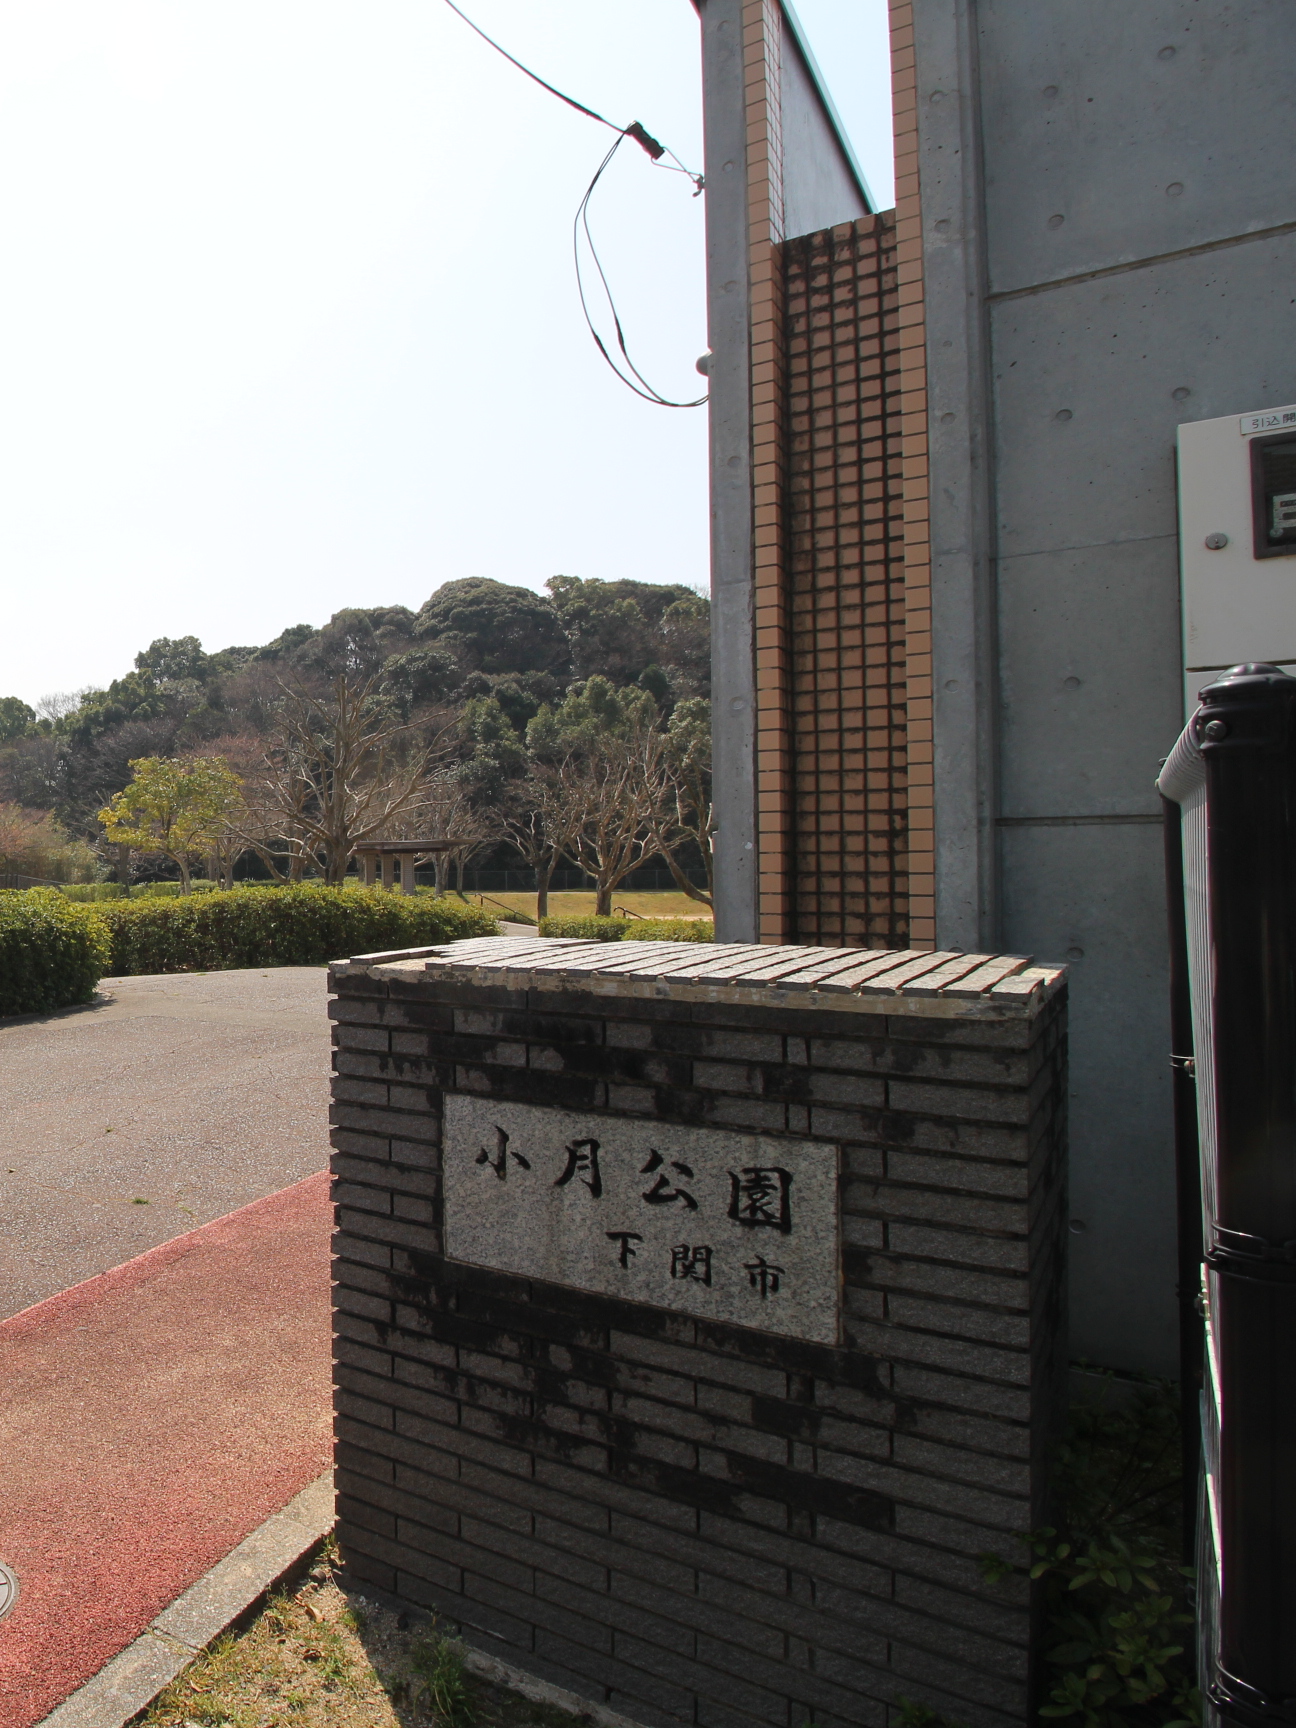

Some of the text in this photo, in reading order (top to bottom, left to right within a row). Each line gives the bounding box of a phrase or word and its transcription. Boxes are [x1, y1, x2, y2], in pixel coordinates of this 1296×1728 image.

[475, 1124, 794, 1235] 小月公園
[606, 1231, 786, 1299] 下関市
